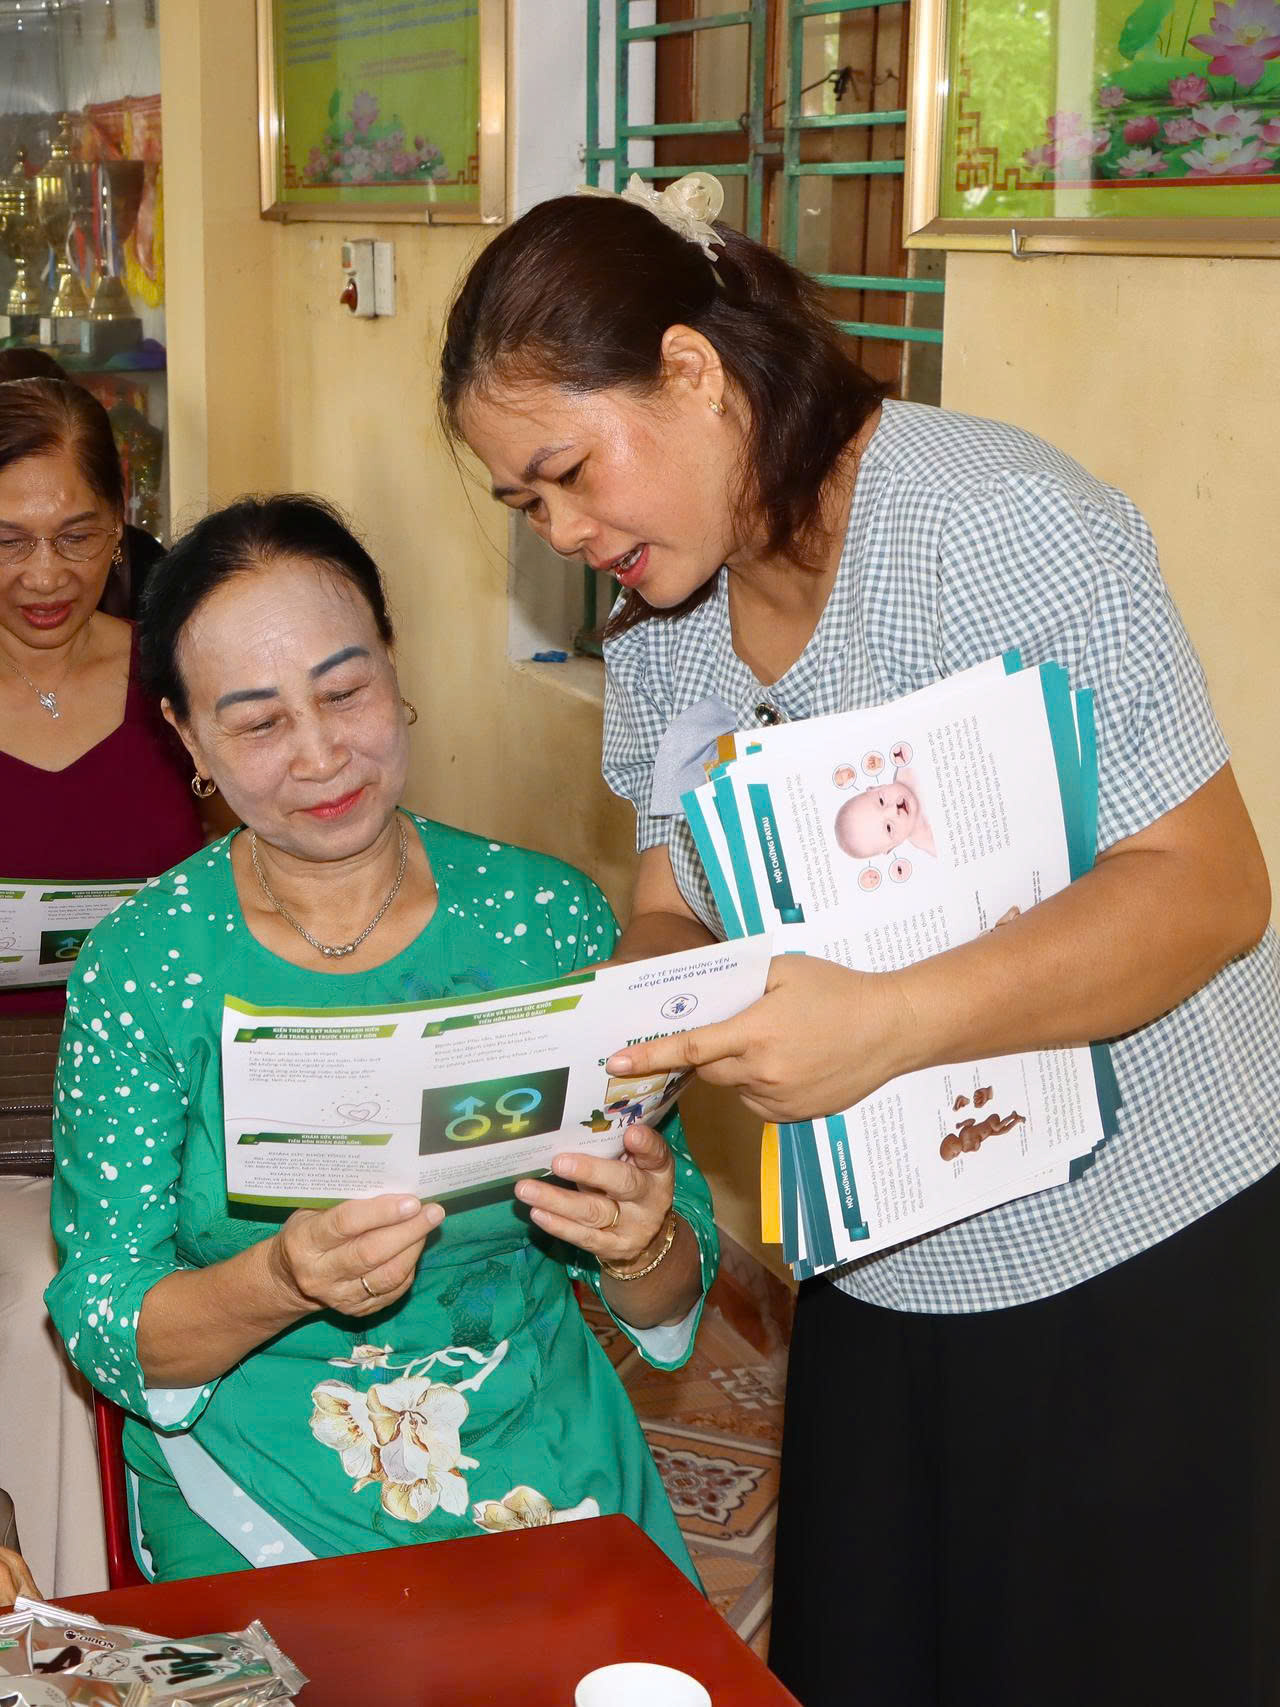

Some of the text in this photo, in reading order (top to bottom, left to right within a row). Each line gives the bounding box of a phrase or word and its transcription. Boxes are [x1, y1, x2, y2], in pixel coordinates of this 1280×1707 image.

[761, 816, 783, 883] HỘI CHỨNG PATAU
[638, 973, 650, 981] SỞ
[667, 965, 687, 974] TỈNH
[688, 960, 713, 970] HƯNG
[714, 956, 729, 965] YÊN
[643, 979, 662, 987] CỤC
[662, 974, 681, 983] DÂN
[695, 968, 706, 976] VÀ
[836, 1140, 854, 1208] HỘI CHỨNG EDWARD
[79, 1635, 115, 1649] ORION
